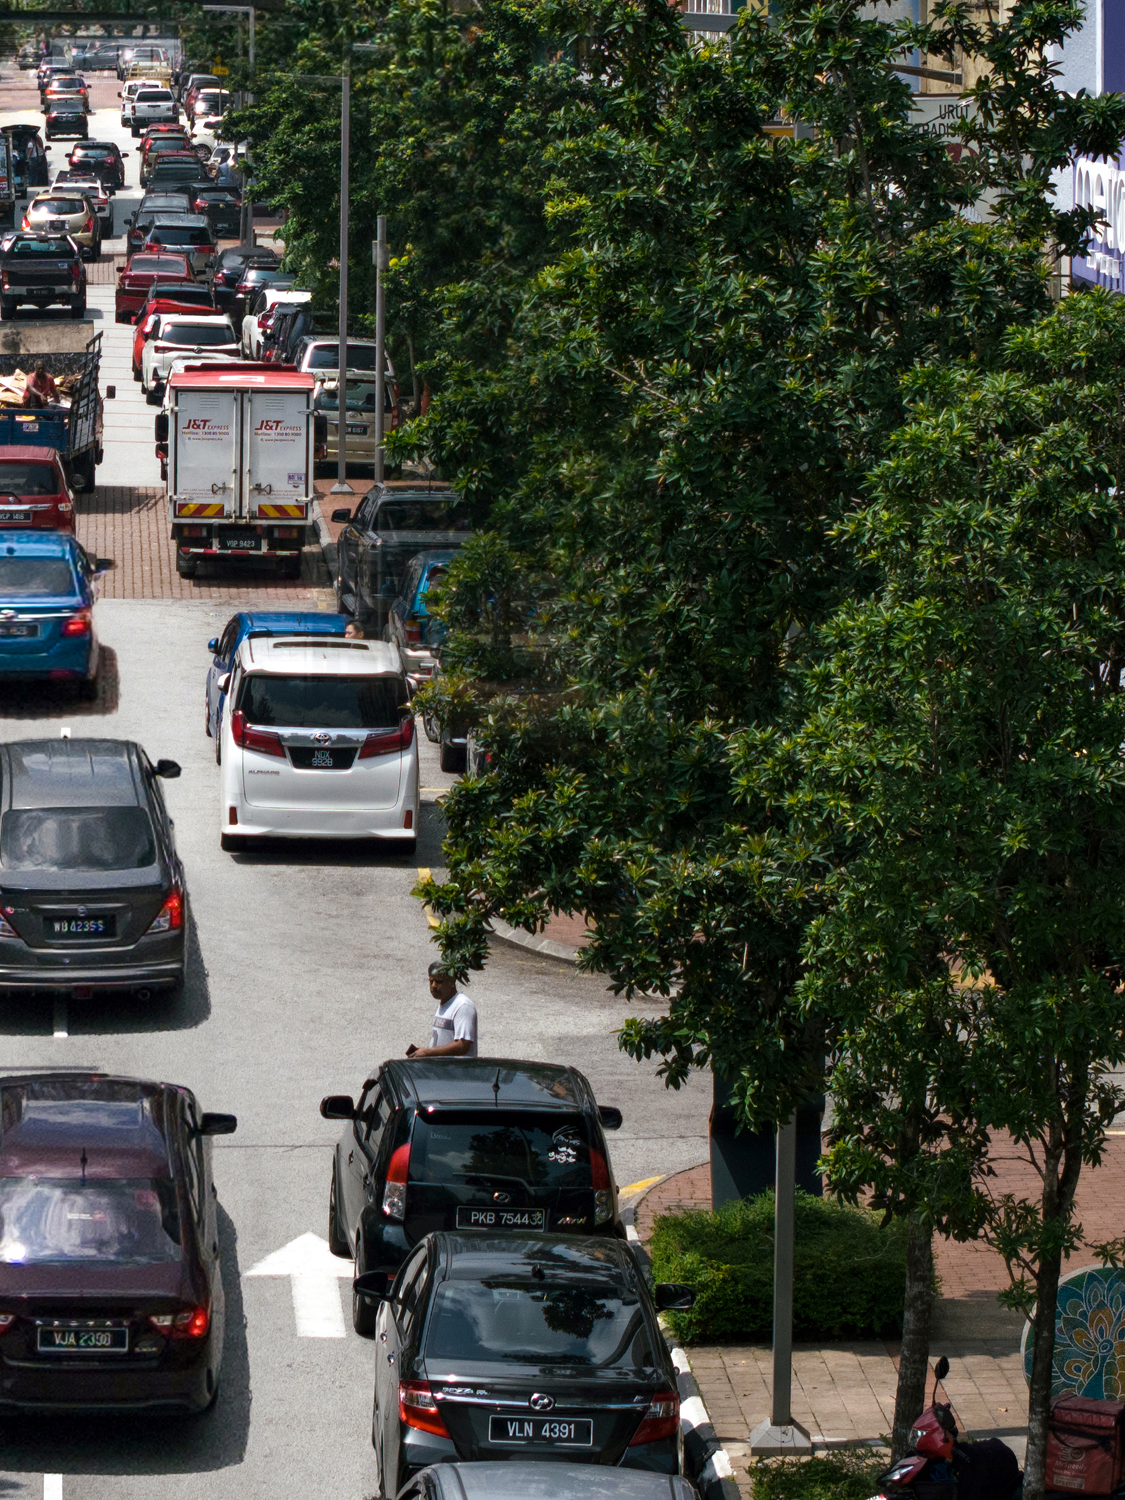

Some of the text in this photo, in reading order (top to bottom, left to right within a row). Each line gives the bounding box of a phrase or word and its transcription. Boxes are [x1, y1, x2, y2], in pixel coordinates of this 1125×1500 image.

[939, 104, 970, 120] URUT
[182, 419, 212, 430] J&T
[254, 420, 285, 431] J&T
[314, 750, 330, 758] NDX
[471, 1212, 529, 1225] PKB 7544
[54, 1332, 77, 1345] VJA
[507, 1421, 575, 1438] VLN 4391
